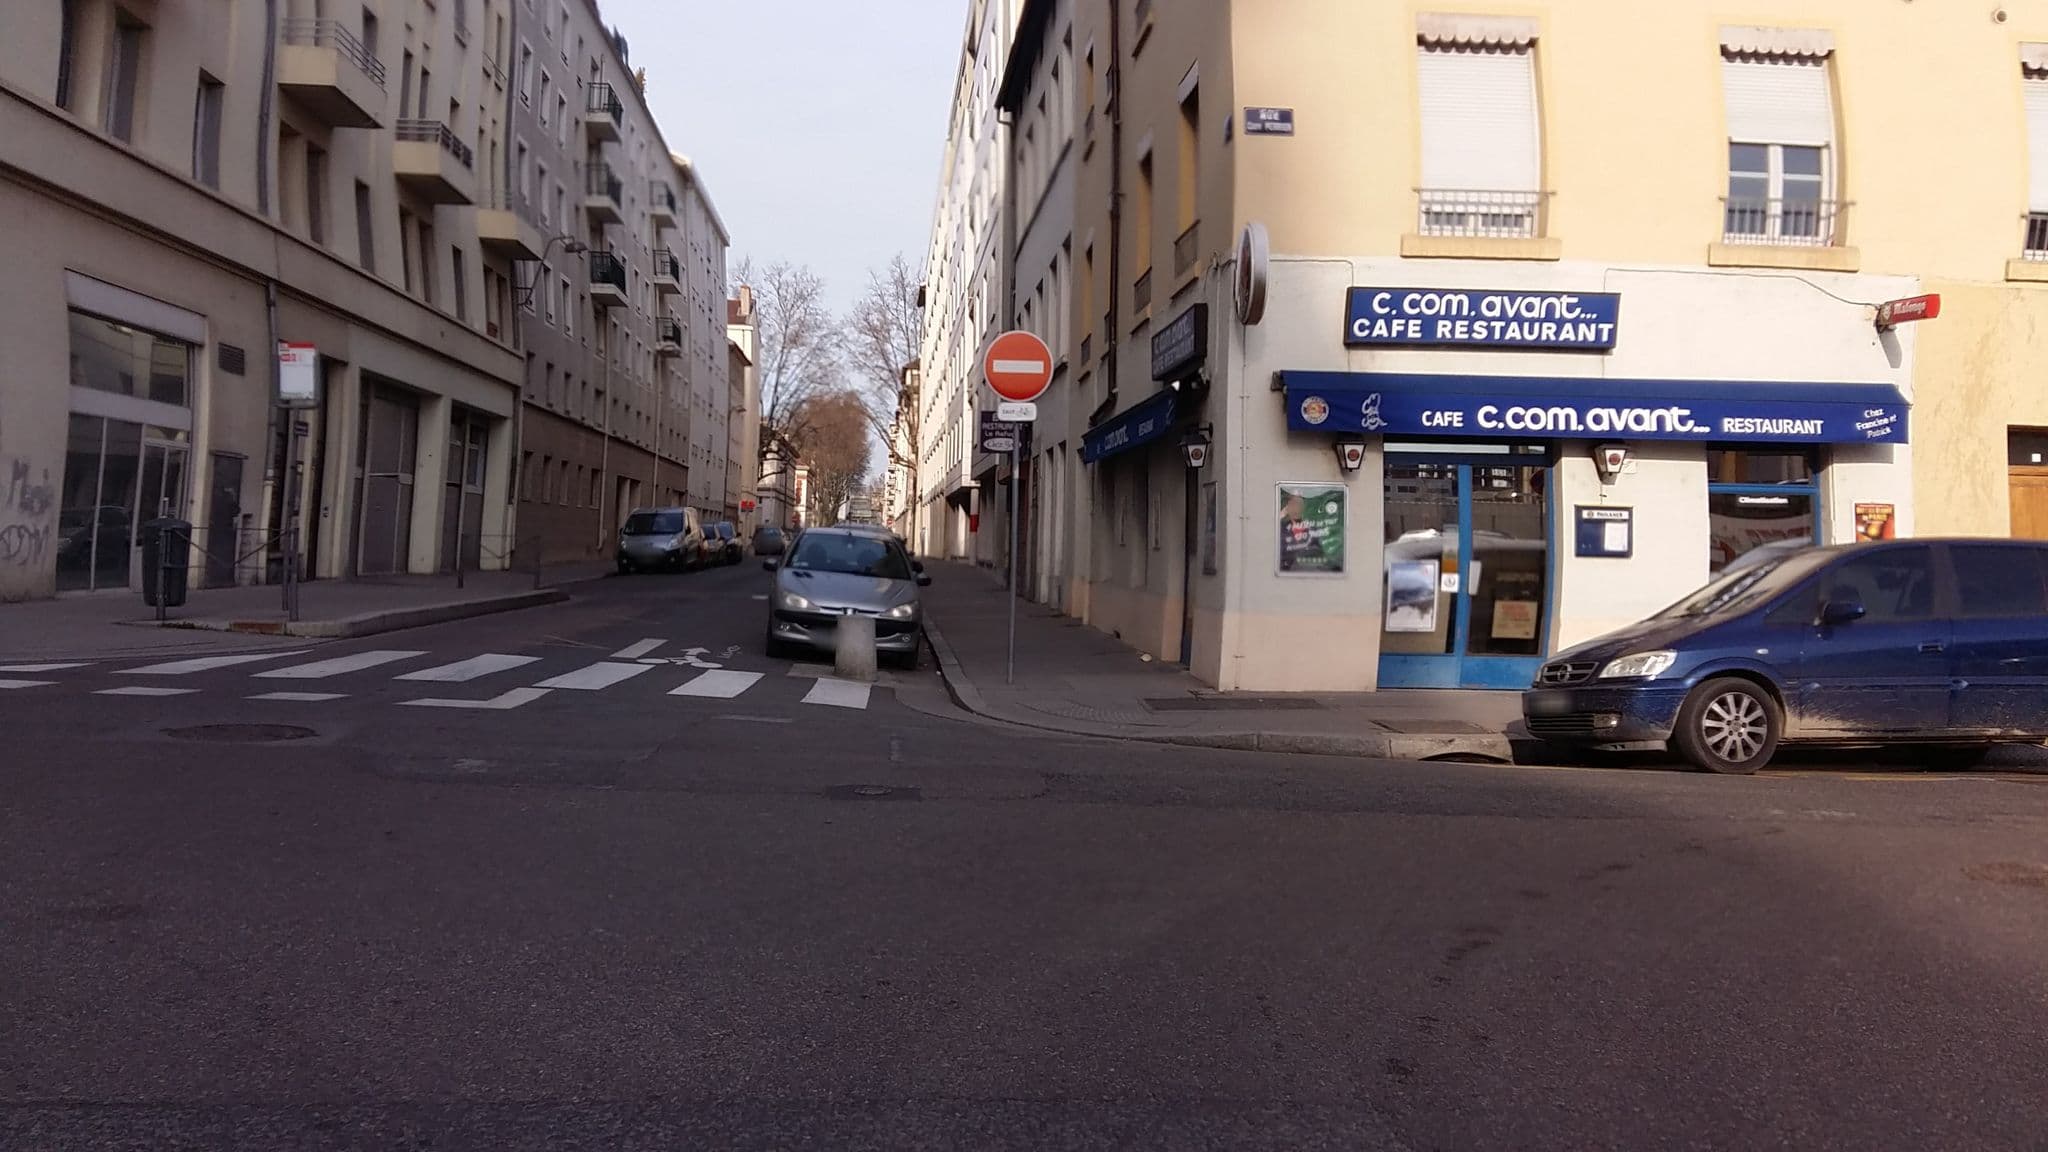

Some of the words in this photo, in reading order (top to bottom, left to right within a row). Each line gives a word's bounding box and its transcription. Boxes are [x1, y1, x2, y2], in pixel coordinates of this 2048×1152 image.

[1353, 318, 1422, 338] CAFE
[1436, 319, 1614, 342] RESTAURANT
[1421, 411, 1464, 427] CAFE
[1723, 417, 1824, 435] RESTAURANT
[1864, 408, 1884, 418] Chez
